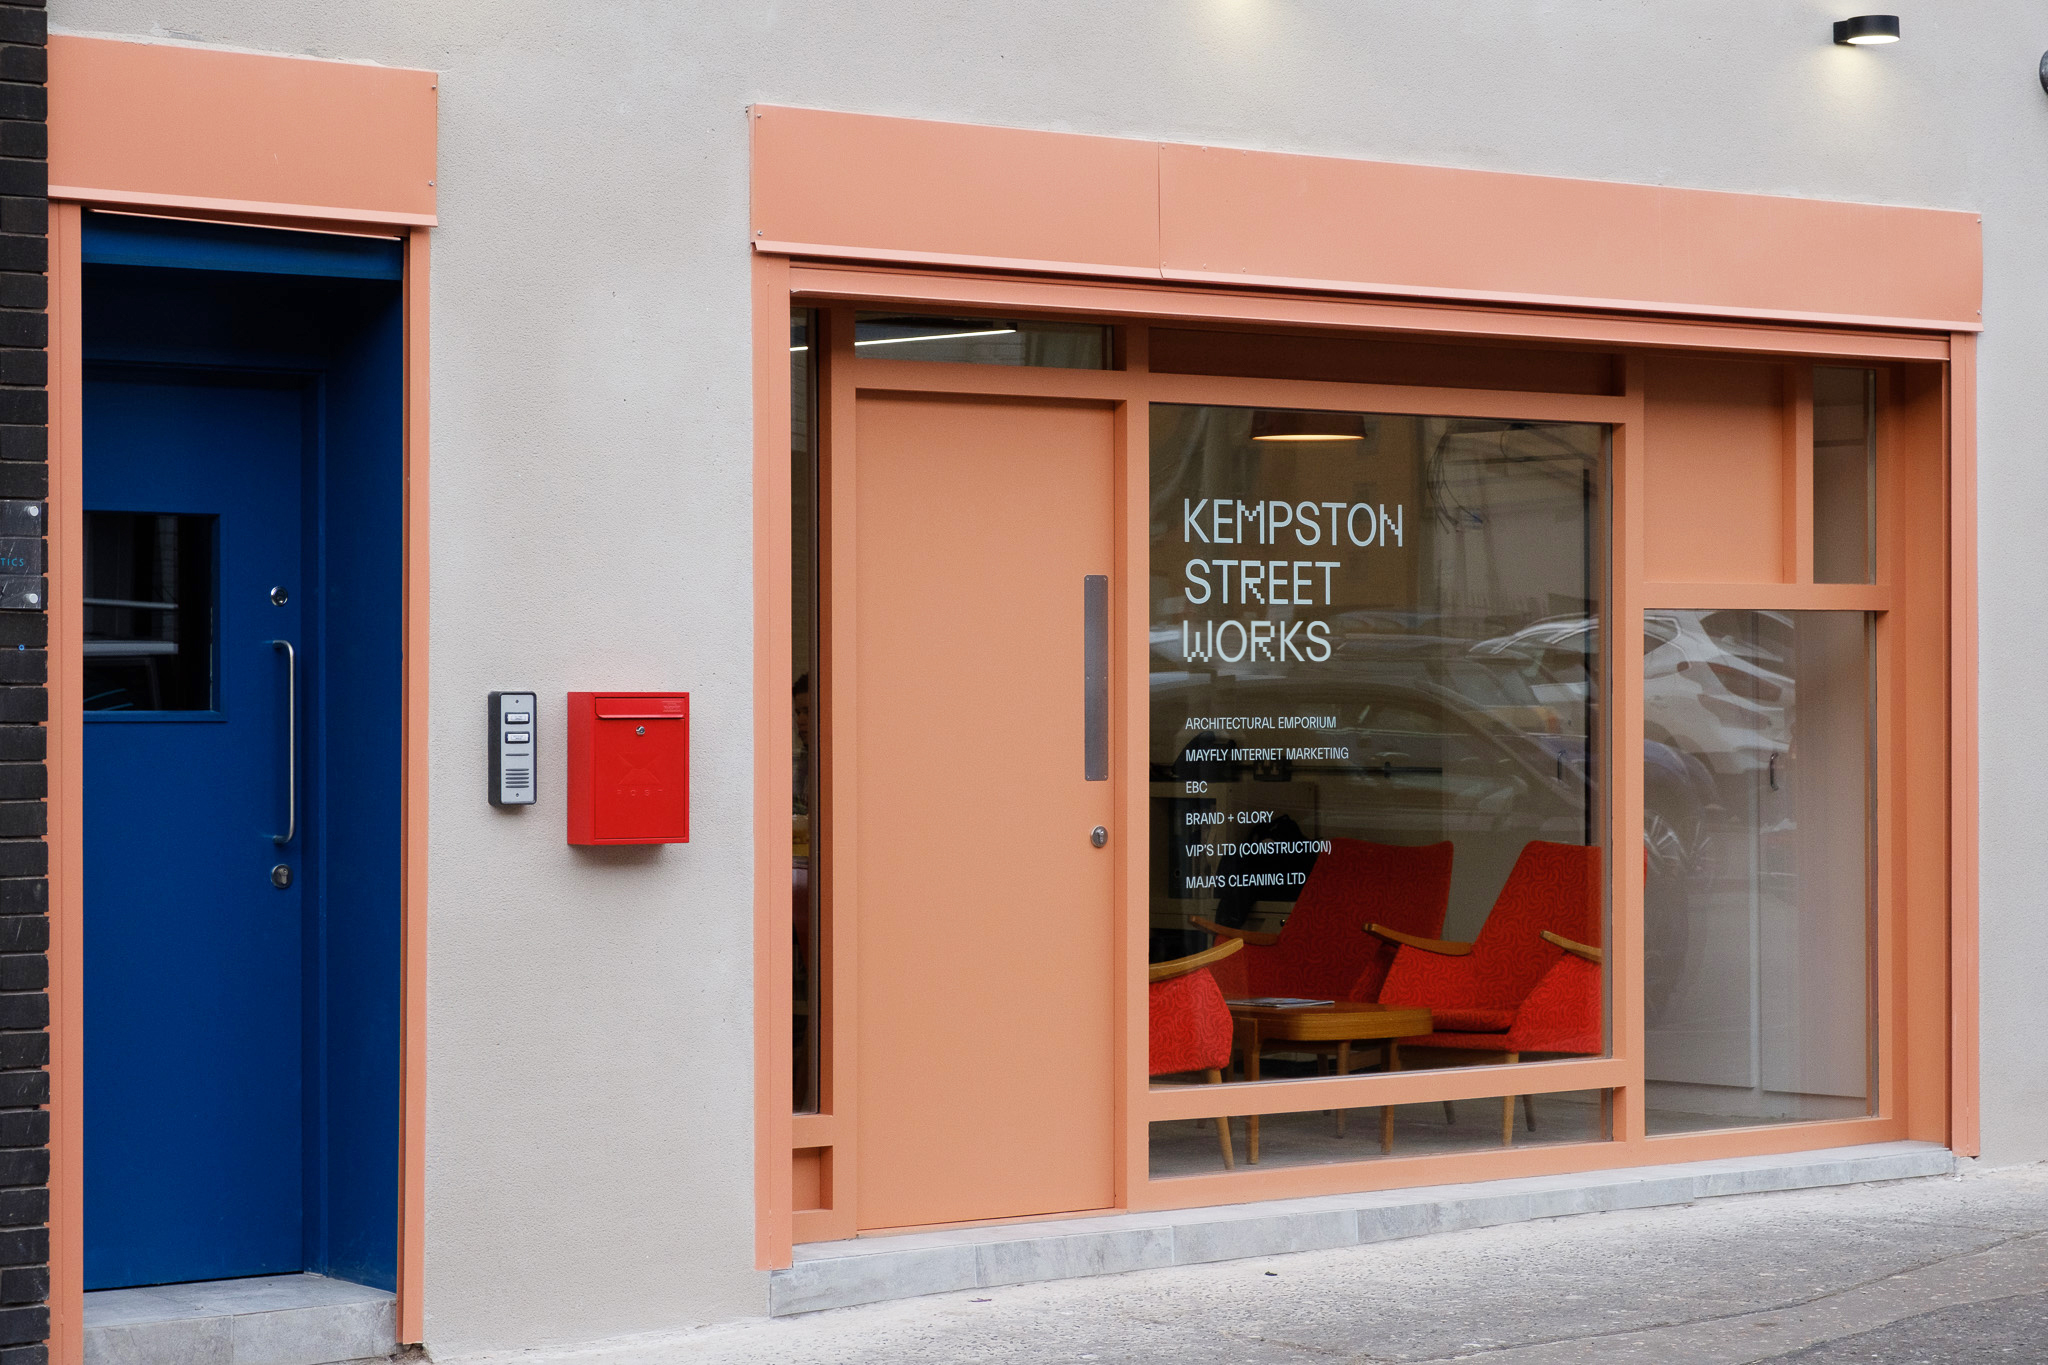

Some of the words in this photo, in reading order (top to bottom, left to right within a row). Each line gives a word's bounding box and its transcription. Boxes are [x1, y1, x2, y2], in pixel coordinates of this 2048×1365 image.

[1184, 498, 1403, 547] KEMPSTON
[1184, 558, 1341, 605] STREET
[1183, 619, 1332, 663] WORKS
[1185, 716, 1275, 729] ARCHITECTURAL
[1278, 716, 1336, 728] EMPORIUM
[1185, 748, 1228, 761] MAYFLY
[1231, 748, 1283, 760] INTERNET
[1286, 747, 1348, 759] MARKETING
[1185, 780, 1207, 793] EBC
[1185, 812, 1224, 825] BRAND
[1227, 813, 1234, 821] +
[1237, 810, 1273, 823] GLORY
[1185, 843, 1214, 856] VIP'S
[1216, 843, 1236, 855] LTD
[1239, 840, 1331, 857] (CONSTRUCTION)
[1185, 874, 1225, 888] MAJA'S
[1228, 872, 1284, 887] CLEANING
[1286, 872, 1305, 884] LTD
